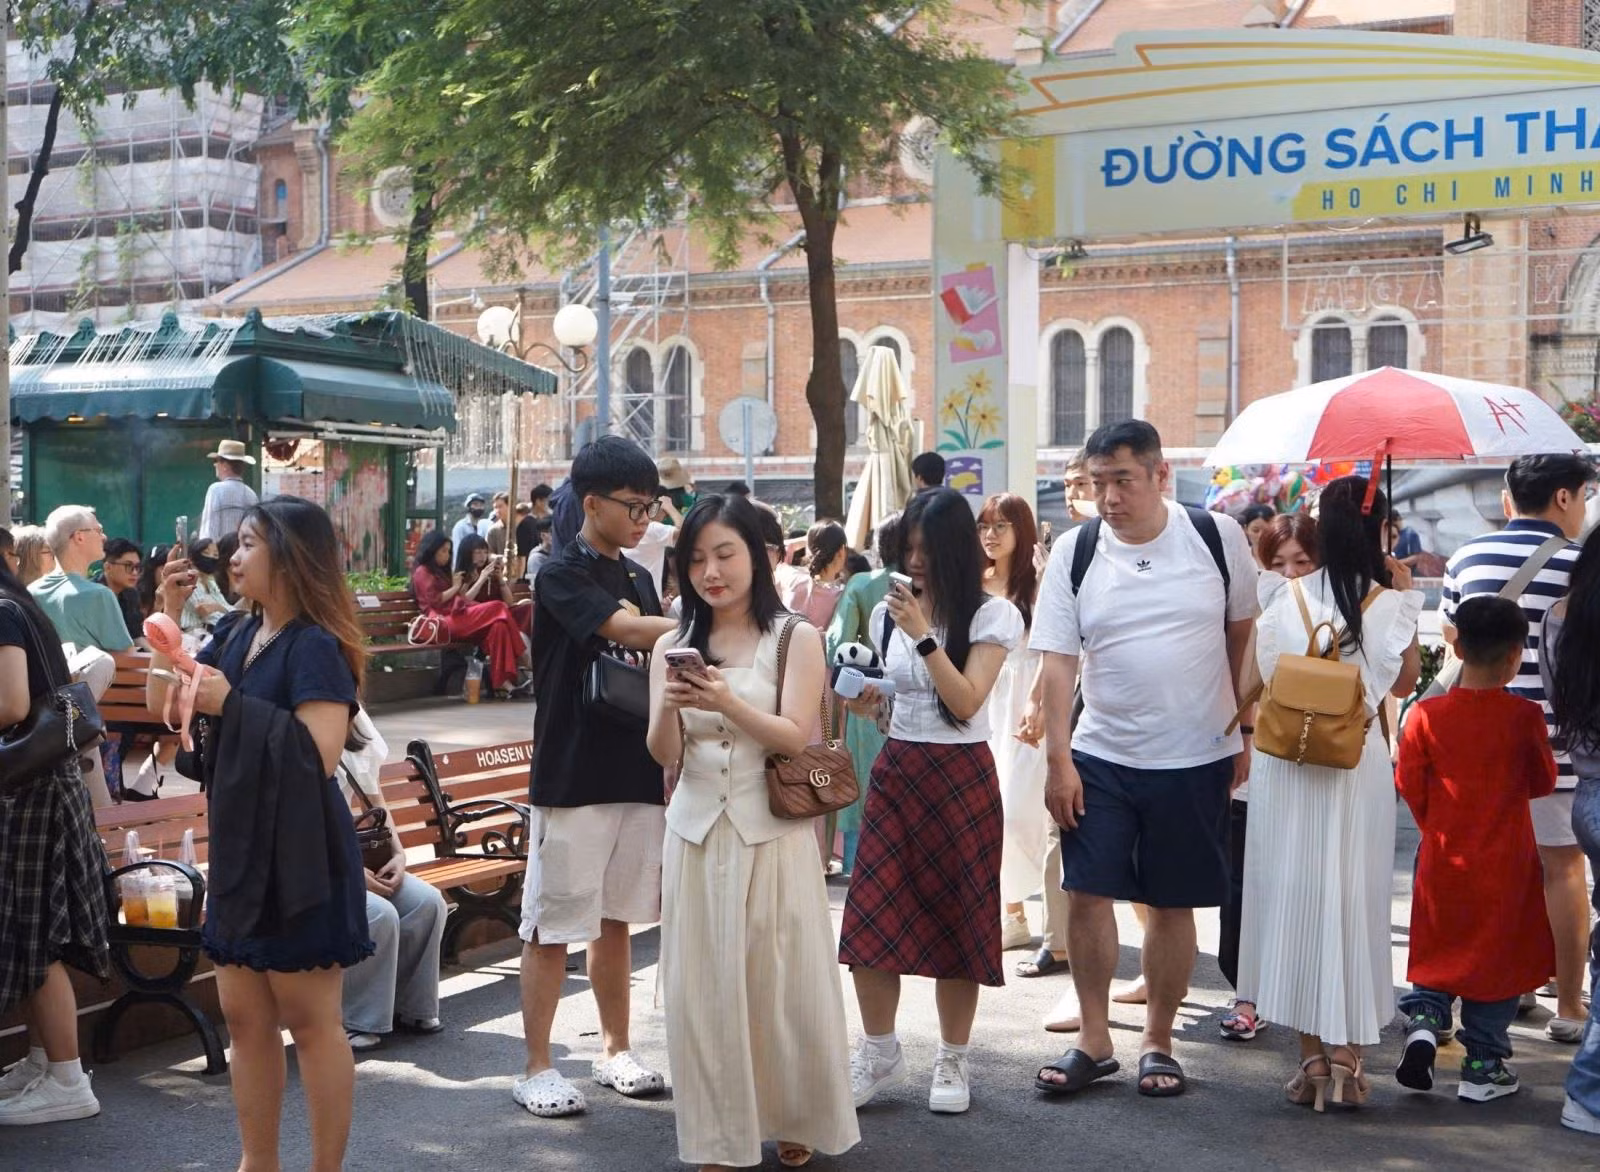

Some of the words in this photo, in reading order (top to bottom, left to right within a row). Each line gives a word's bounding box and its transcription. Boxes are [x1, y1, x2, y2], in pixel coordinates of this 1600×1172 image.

[1101, 130, 1306, 187] ĐƯỜNG
[1325, 113, 1484, 169] SÁCH
[1505, 107, 1600, 155] TH
[1322, 189, 1361, 210] HO
[1396, 180, 1457, 205] CHI
[1495, 170, 1593, 198] MINH
[476, 746, 525, 767] HOASEN
